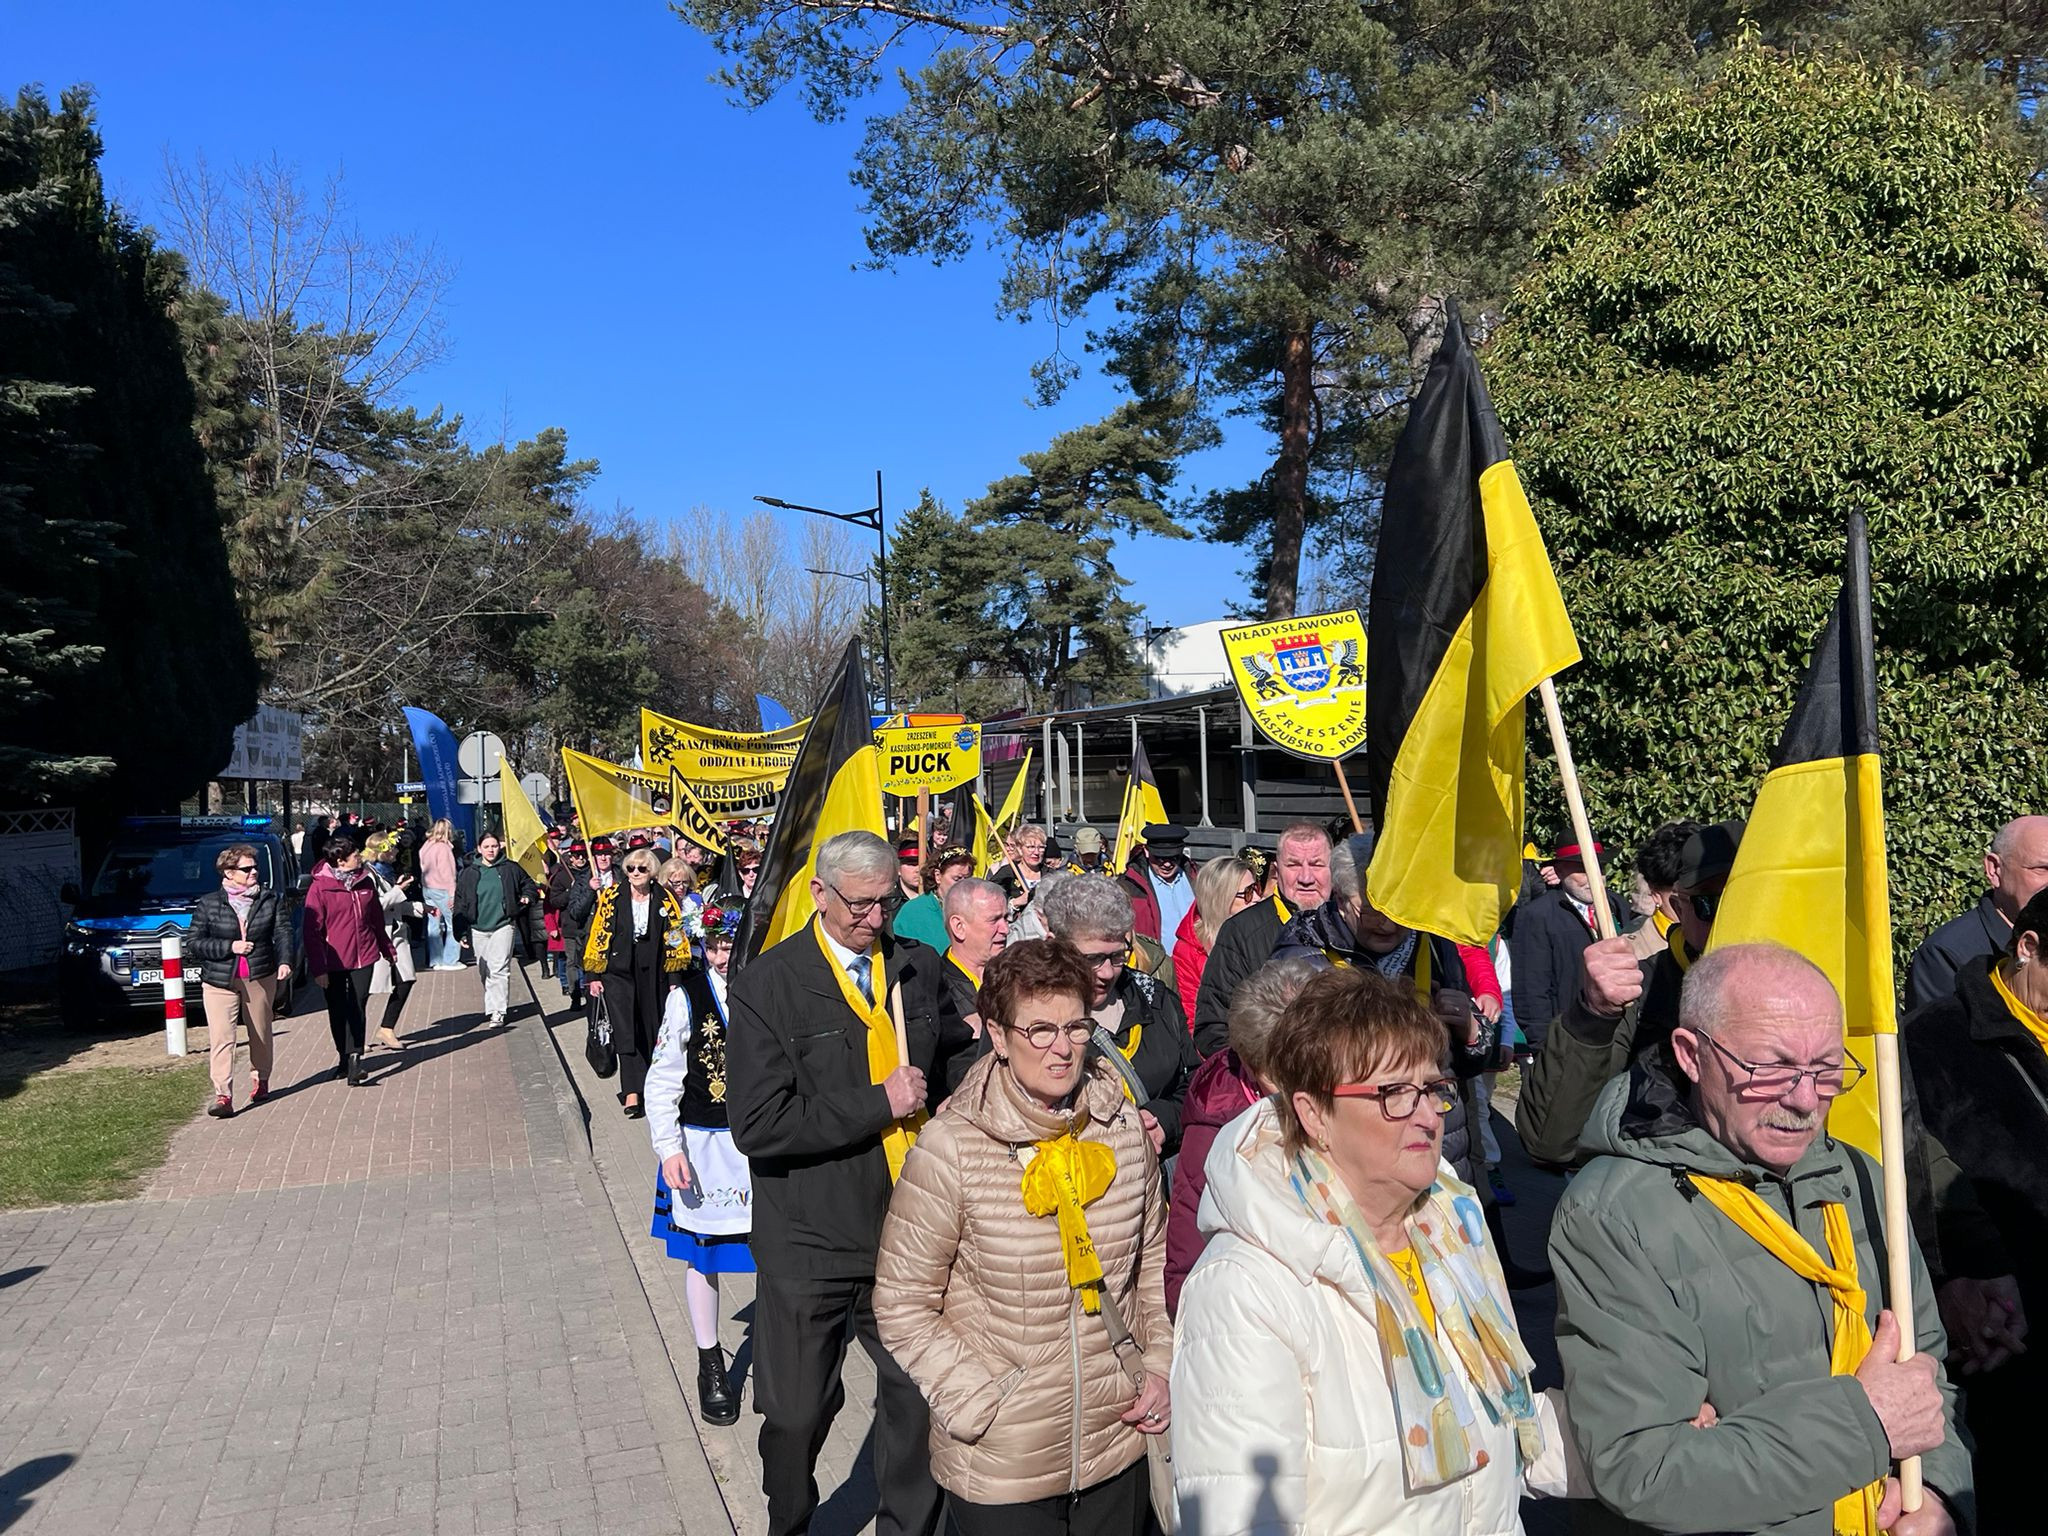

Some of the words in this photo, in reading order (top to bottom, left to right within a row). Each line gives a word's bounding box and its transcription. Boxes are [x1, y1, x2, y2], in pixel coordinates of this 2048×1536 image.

[1228, 614, 1355, 642] WŁADYSŁAWOWO
[1275, 700, 1361, 738] ZRZESZENIE
[906, 731, 937, 741] ZRZESZENIE
[1256, 709, 1324, 752] KASZUBSKO
[699, 756, 749, 767] ODDZIAŁ
[890, 752, 951, 775] PUCK
[694, 781, 775, 800] KASZUBSKO
[666, 949, 689, 958] PUCK
[1078, 1243, 1096, 1258] ZK
